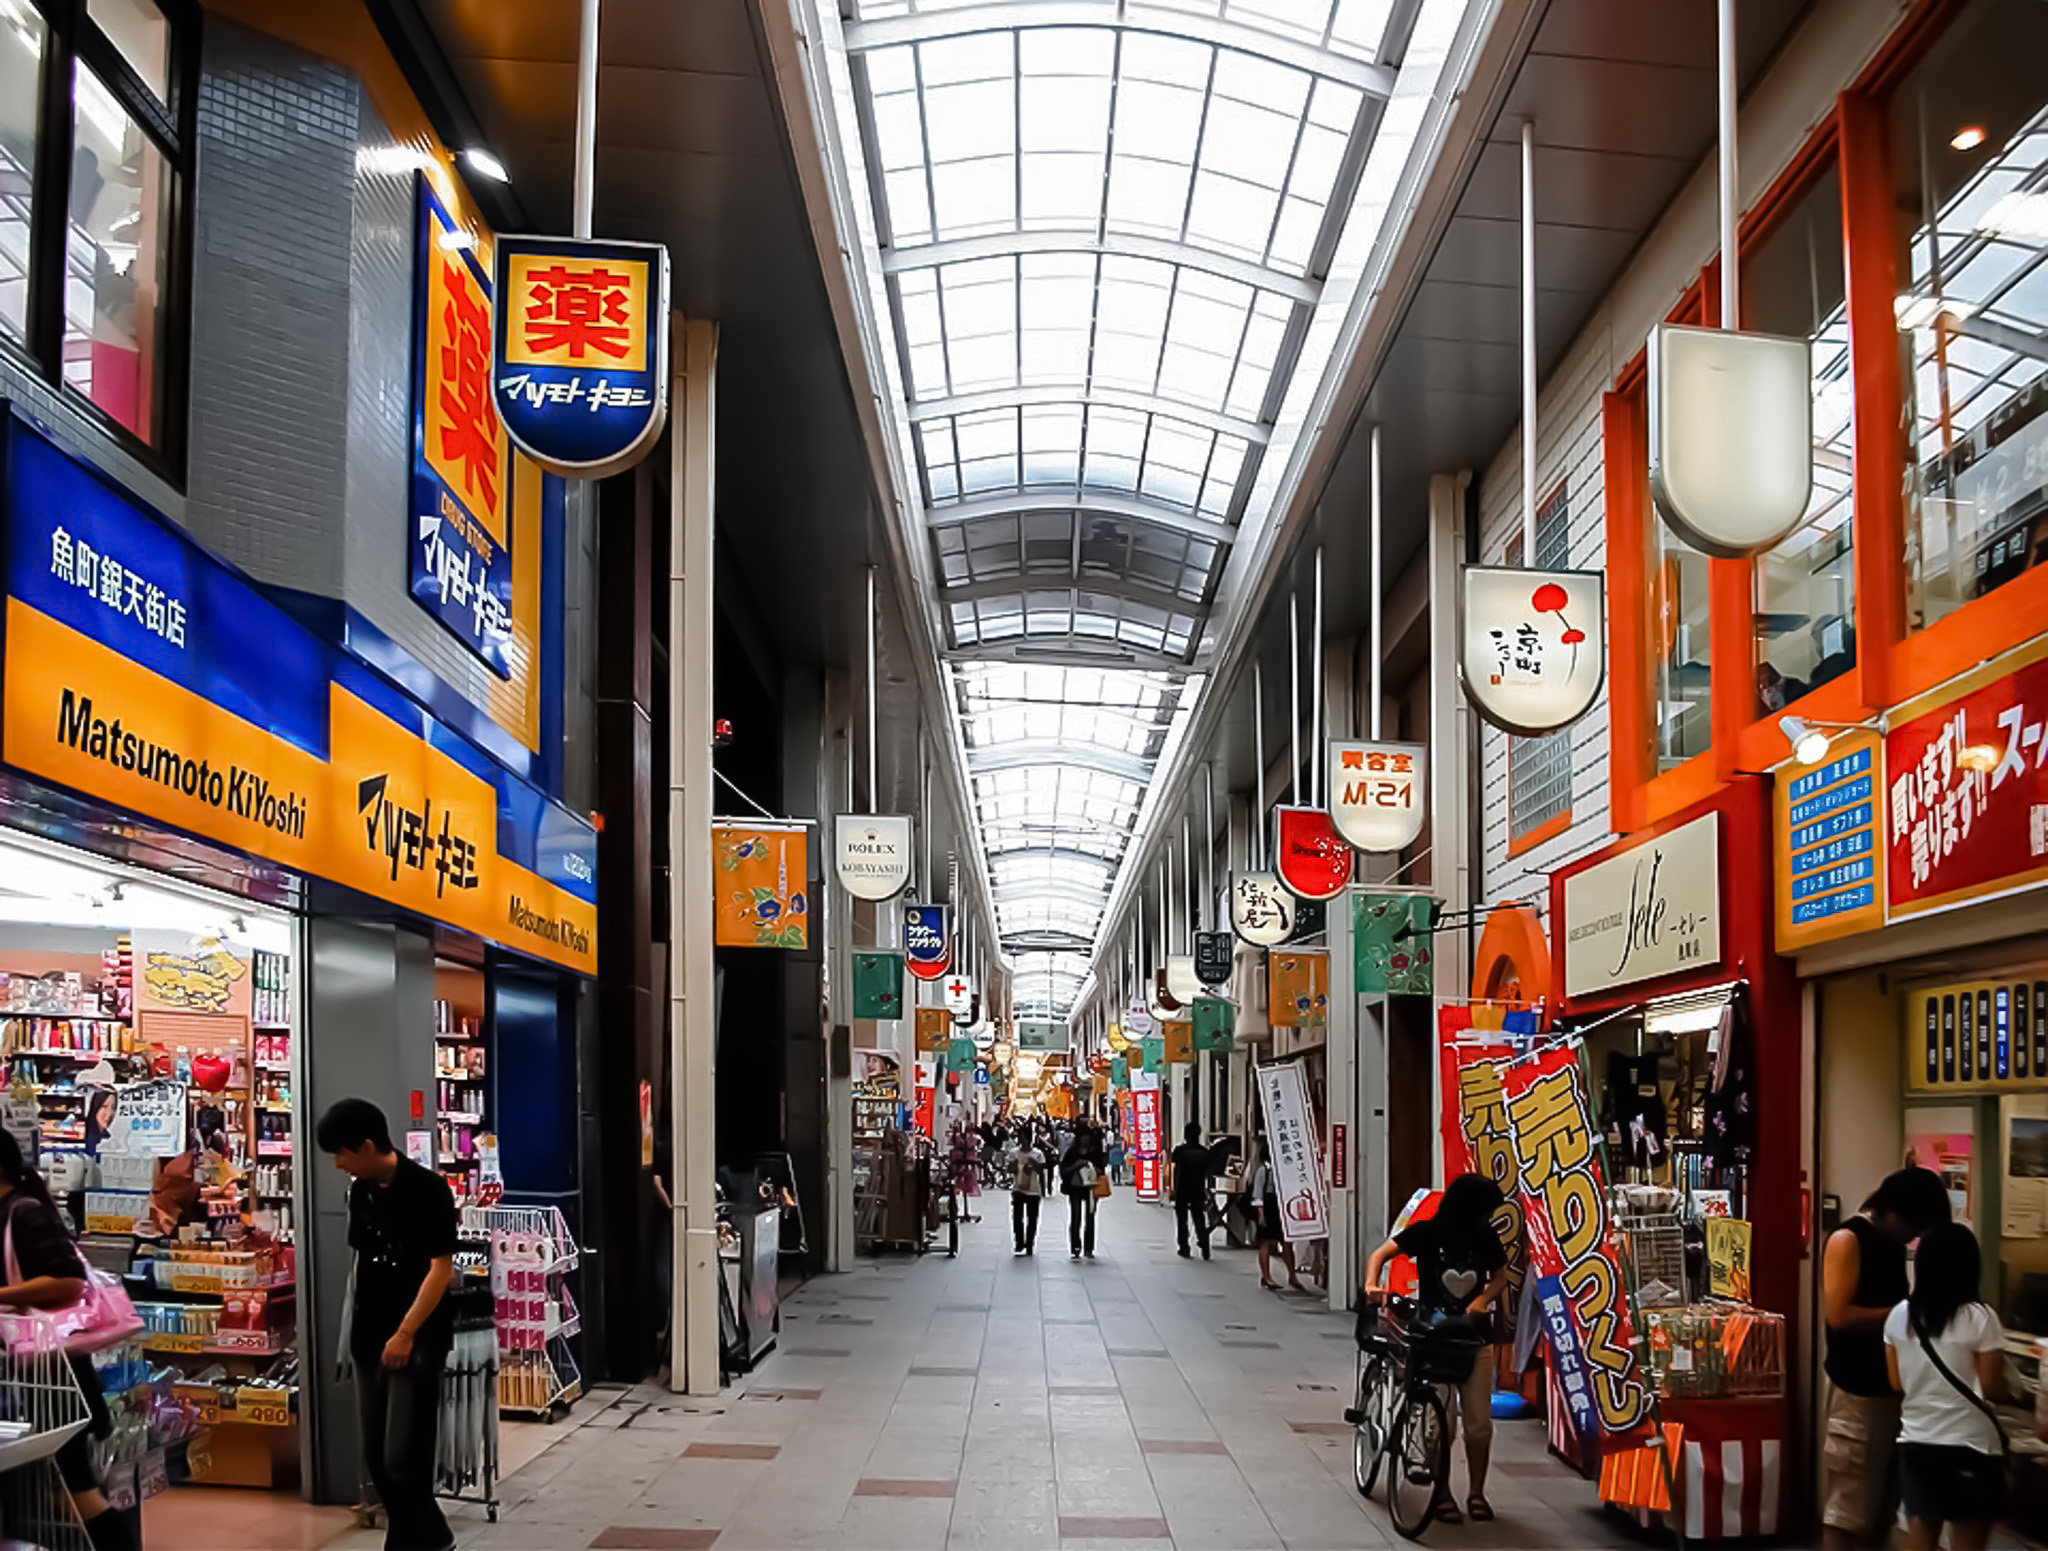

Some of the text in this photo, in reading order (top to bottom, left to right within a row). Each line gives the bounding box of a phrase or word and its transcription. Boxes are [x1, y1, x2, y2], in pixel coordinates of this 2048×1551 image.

[524, 265, 631, 359] 薬
[440, 257, 499, 517] 薬
[50, 526, 187, 649] 魚町銀天街店
[57, 687, 307, 840] Matsumoto KiYoshi
[841, 862, 904, 876] KOBAYASHI
[848, 844, 896, 855] ROLEX
[1508, 1067, 1642, 1430] 売りつくし
